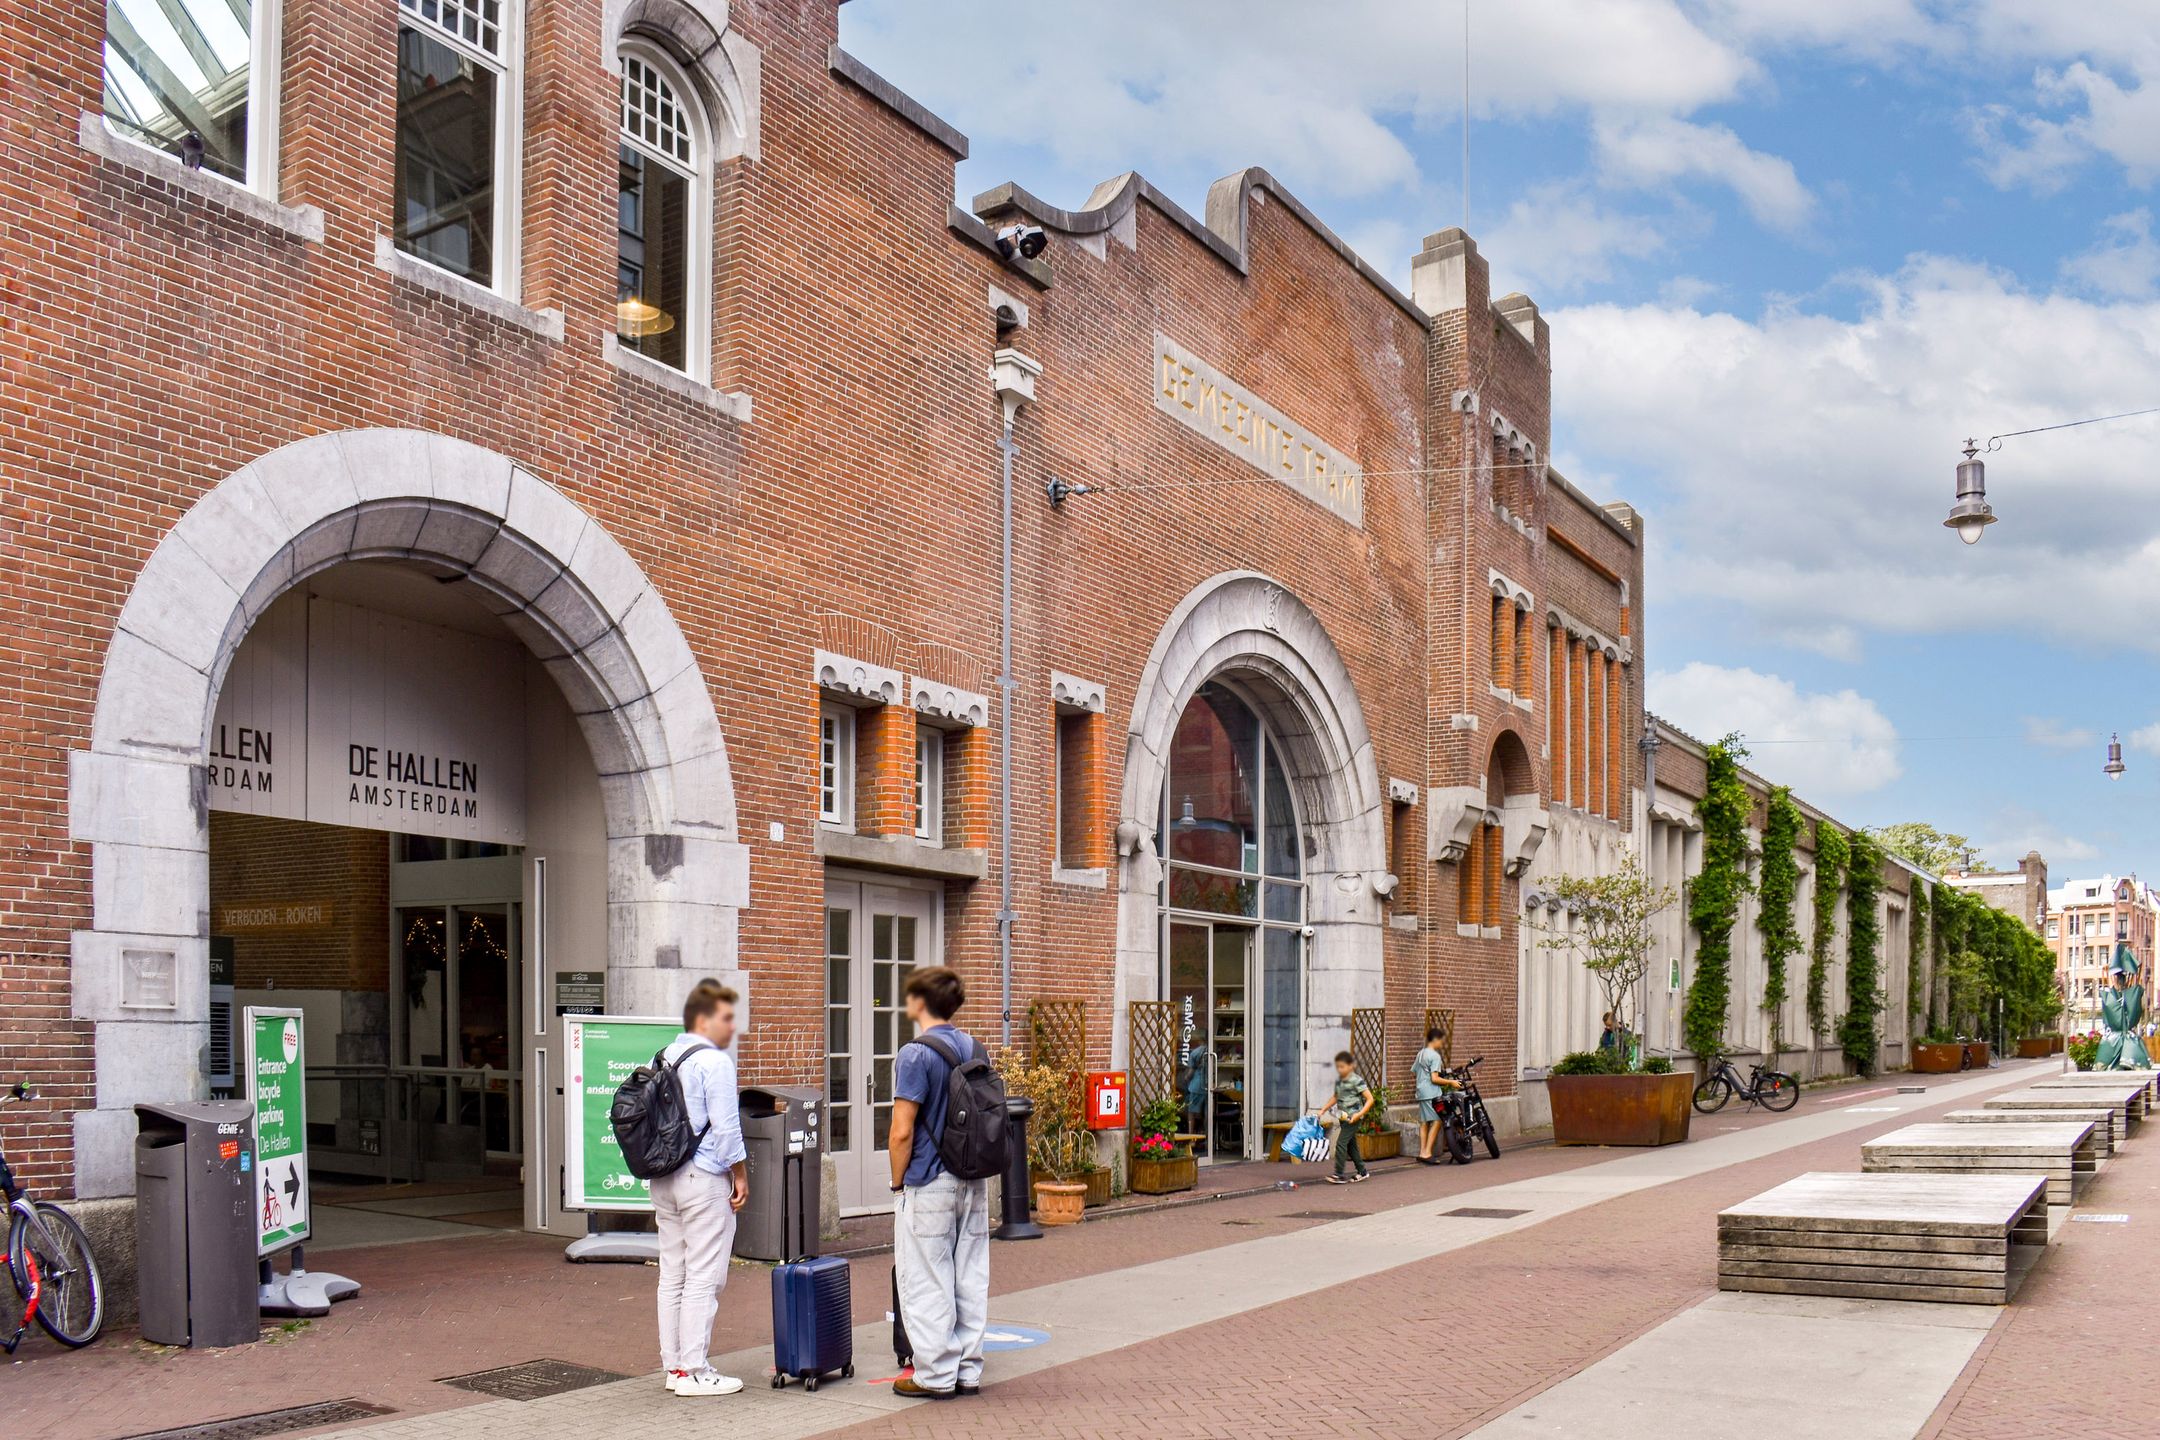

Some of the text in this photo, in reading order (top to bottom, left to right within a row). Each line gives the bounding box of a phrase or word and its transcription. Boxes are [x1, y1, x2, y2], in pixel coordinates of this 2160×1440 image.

[1163, 354, 1357, 511] GEMEENTE TRAM
[209, 724, 272, 765] LEN
[349, 743, 477, 793] DE HALLEN
[349, 783, 477, 818] AMSTERDAM
[224, 906, 322, 926] VERBODEN ROKEN
[284, 1032, 296, 1046] FREE
[257, 1057, 287, 1075] Entrance
[258, 1081, 281, 1104] bicycle
[1106, 1095, 1113, 1109] B
[259, 1105, 284, 1129] parking
[217, 1123, 239, 1135] GENIE
[260, 1136, 269, 1154] De
[270, 1132, 291, 1152] Hallen
